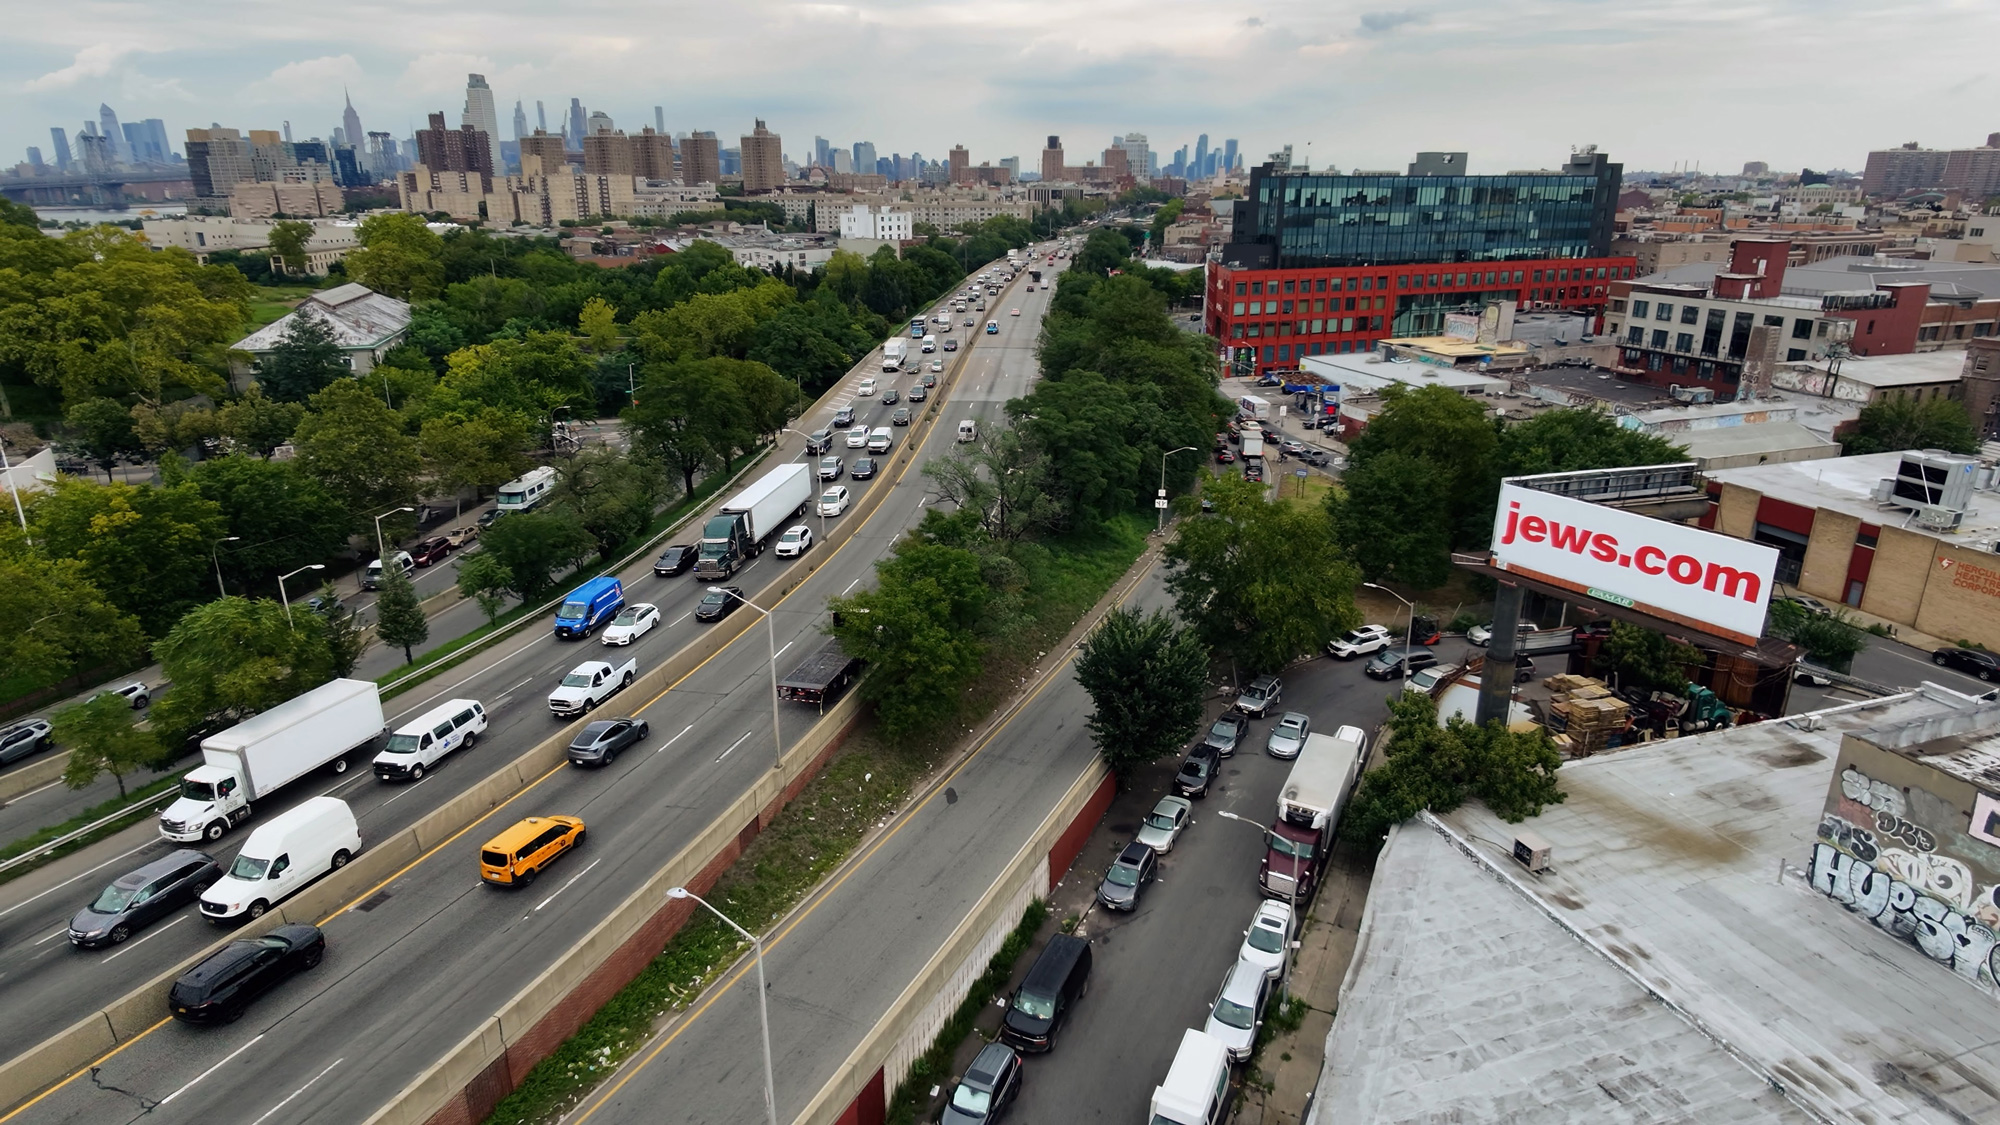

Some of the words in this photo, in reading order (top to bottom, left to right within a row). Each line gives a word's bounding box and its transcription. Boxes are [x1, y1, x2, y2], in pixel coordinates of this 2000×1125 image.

[1501, 500, 1761, 604] jews.com
[1954, 569, 1981, 583] HEAT
[1591, 588, 1630, 606] LAMAR
[1952, 577, 2000, 599] CORPORA
